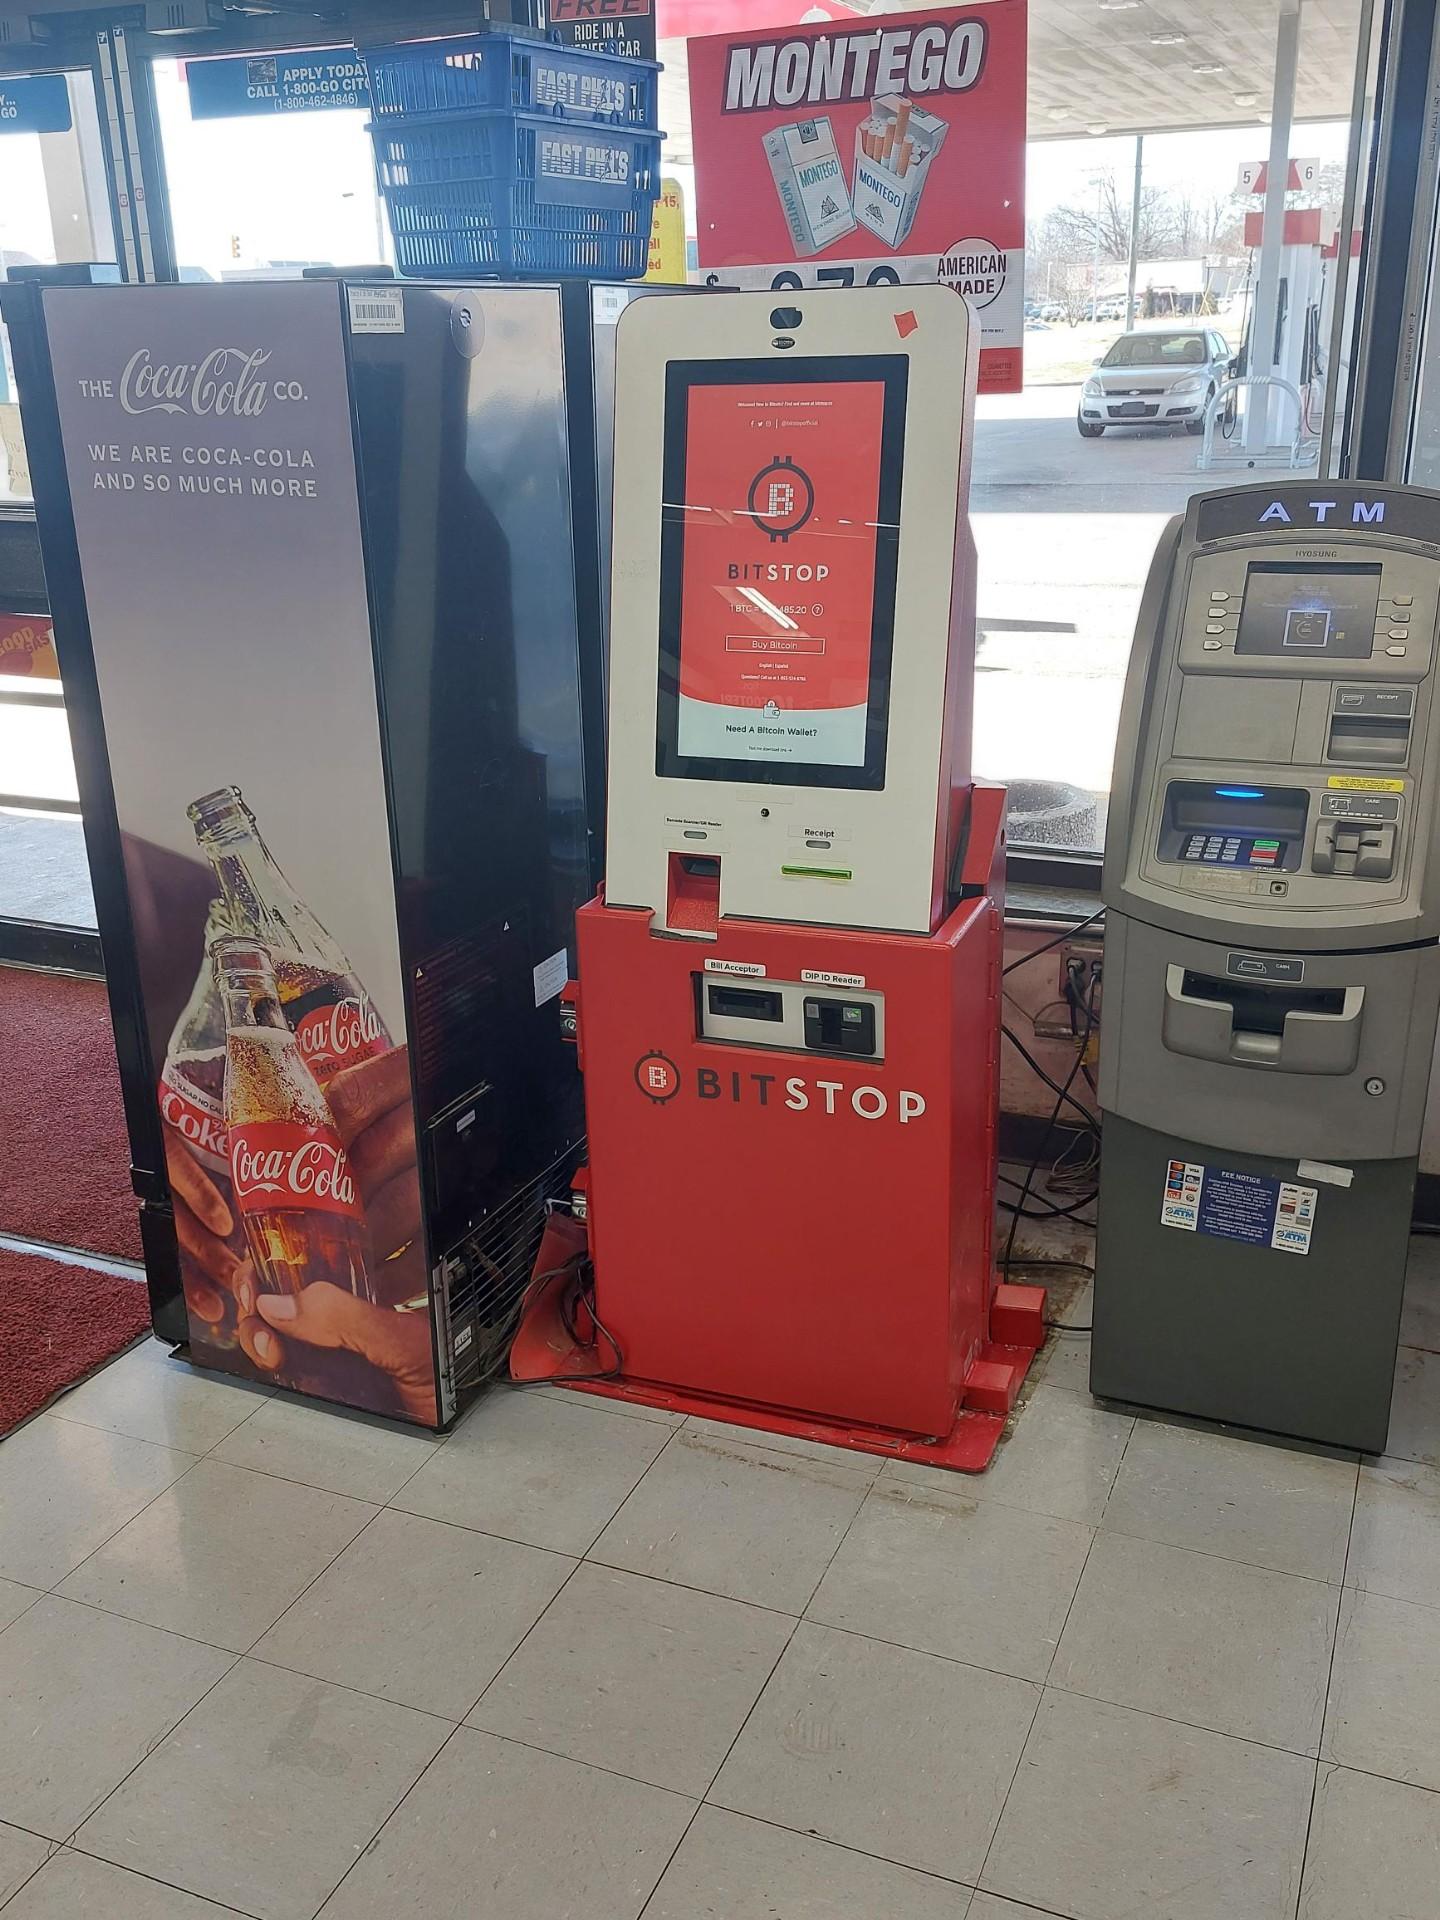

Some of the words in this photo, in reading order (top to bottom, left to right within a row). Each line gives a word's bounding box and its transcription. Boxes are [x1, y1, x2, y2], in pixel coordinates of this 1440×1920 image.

[574, 23, 599, 41] RIDE
[602, 22, 614, 39] IN
[617, 21, 625, 38] A
[618, 40, 641, 57] CAR
[284, 67, 322, 82] APPLY
[726, 23, 984, 110] MONTEGO
[247, 85, 279, 98] CALL
[283, 80, 338, 95] 1-800-GO
[343, 76, 369, 91] CIT
[537, 68, 578, 104] FAST
[274, 92, 358, 111] (1-800-462-4846)
[542, 141, 582, 175] FAST
[799, 160, 839, 189] MONTEGO
[1243, 170, 1251, 184] 5
[1305, 166, 1313, 181] 6
[860, 169, 901, 208] MONTEGO
[780, 180, 806, 243] MONTEGO
[938, 254, 1007, 277] AMERICAN
[79, 379, 114, 398] THE
[120, 347, 273, 417] Coca-Cola
[273, 381, 309, 401] CO.
[88, 444, 121, 462] WE
[131, 445, 172, 463] ARE
[183, 446, 315, 468] COCA-COLA
[93, 472, 135, 490] AND
[143, 474, 170, 491] SO
[179, 475, 242, 495] MUCH
[251, 477, 318, 497] MORE
[1258, 501, 1386, 523] ATM
[728, 563, 830, 582] BITSTOP
[735, 604, 753, 613] BTC
[752, 640, 768, 651] Buy
[770, 641, 798, 650] Bitcoin
[725, 724, 747, 733] Need
[748, 726, 755, 734] A
[757, 726, 785, 735] Bitcoin
[787, 727, 818, 737] Wallet?
[804, 828, 835, 839] Receipt
[710, 961, 723, 971] Bill
[724, 962, 760, 975] Acceptor
[805, 971, 819, 981] DIP
[821, 972, 831, 982] ID
[832, 973, 862, 986] Reader
[696, 1067, 926, 1124] BITSTOP
[162, 1092, 229, 1158] Coke
[231, 1138, 355, 1205] Coca-Cola
[1221, 1170, 1235, 1179] FEE
[1236, 1173, 1261, 1184] NOTICE
